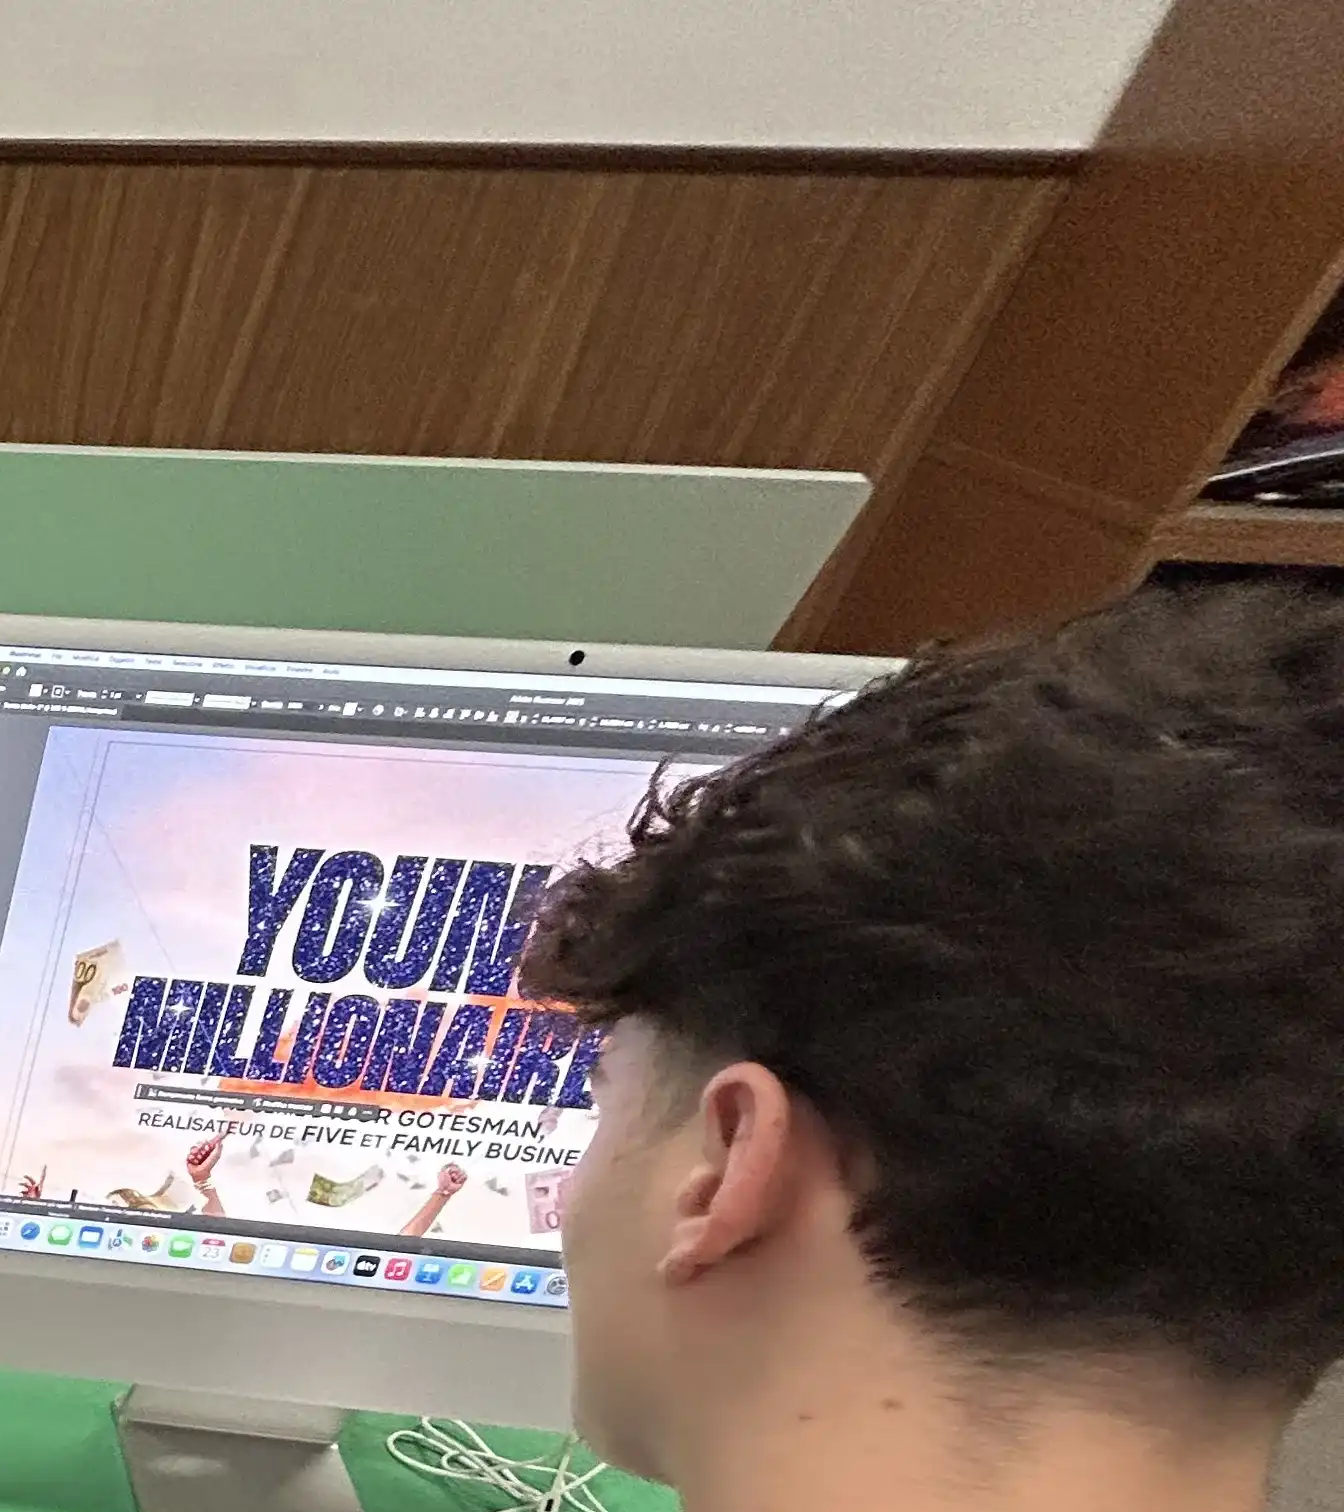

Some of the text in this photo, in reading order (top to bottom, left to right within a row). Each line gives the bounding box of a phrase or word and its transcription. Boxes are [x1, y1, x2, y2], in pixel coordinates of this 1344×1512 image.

[237, 843, 554, 997] YOUN
[138, 1108, 581, 1166] RÉALISATEUR DE FIVE ET FAMILY BUSINE
[398, 1109, 545, 1143] GOTESMAN,
